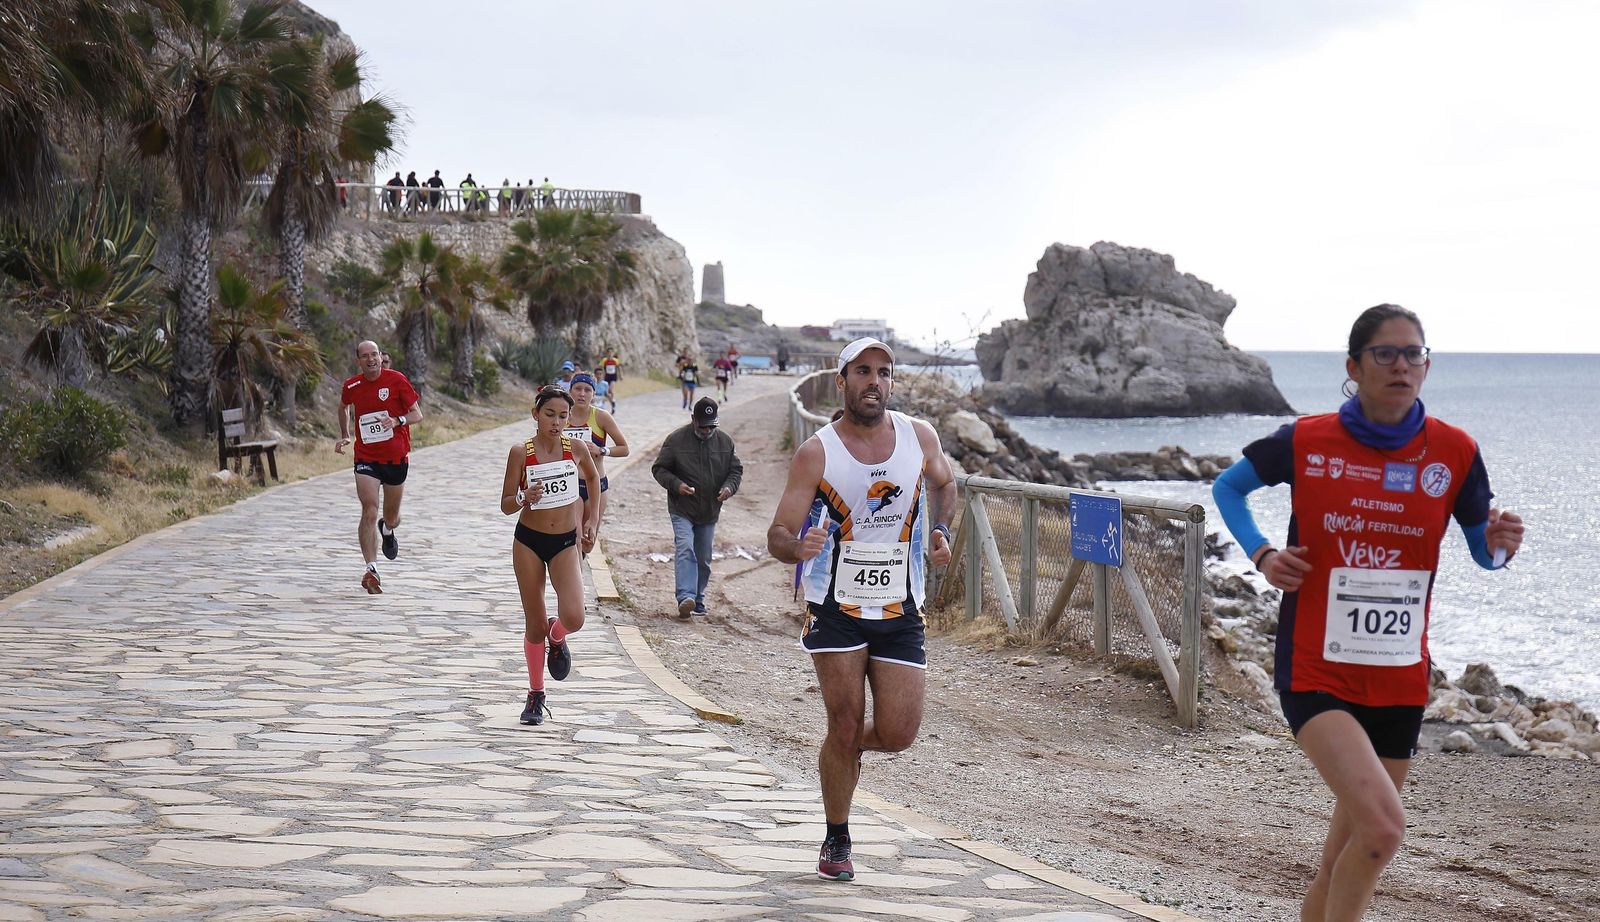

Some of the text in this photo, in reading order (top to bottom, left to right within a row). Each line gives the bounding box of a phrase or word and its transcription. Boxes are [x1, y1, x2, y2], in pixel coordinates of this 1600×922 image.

[369, 423, 381, 434] 89
[544, 479, 568, 495] 463
[1351, 497, 1404, 513] ATLETISMO
[873, 513, 902, 524] RINCÓN
[1368, 521, 1424, 537] FERTILIDAD
[853, 568, 891, 586] 456
[1347, 607, 1411, 636] 1029
[1352, 648, 1378, 656] CARRERA
